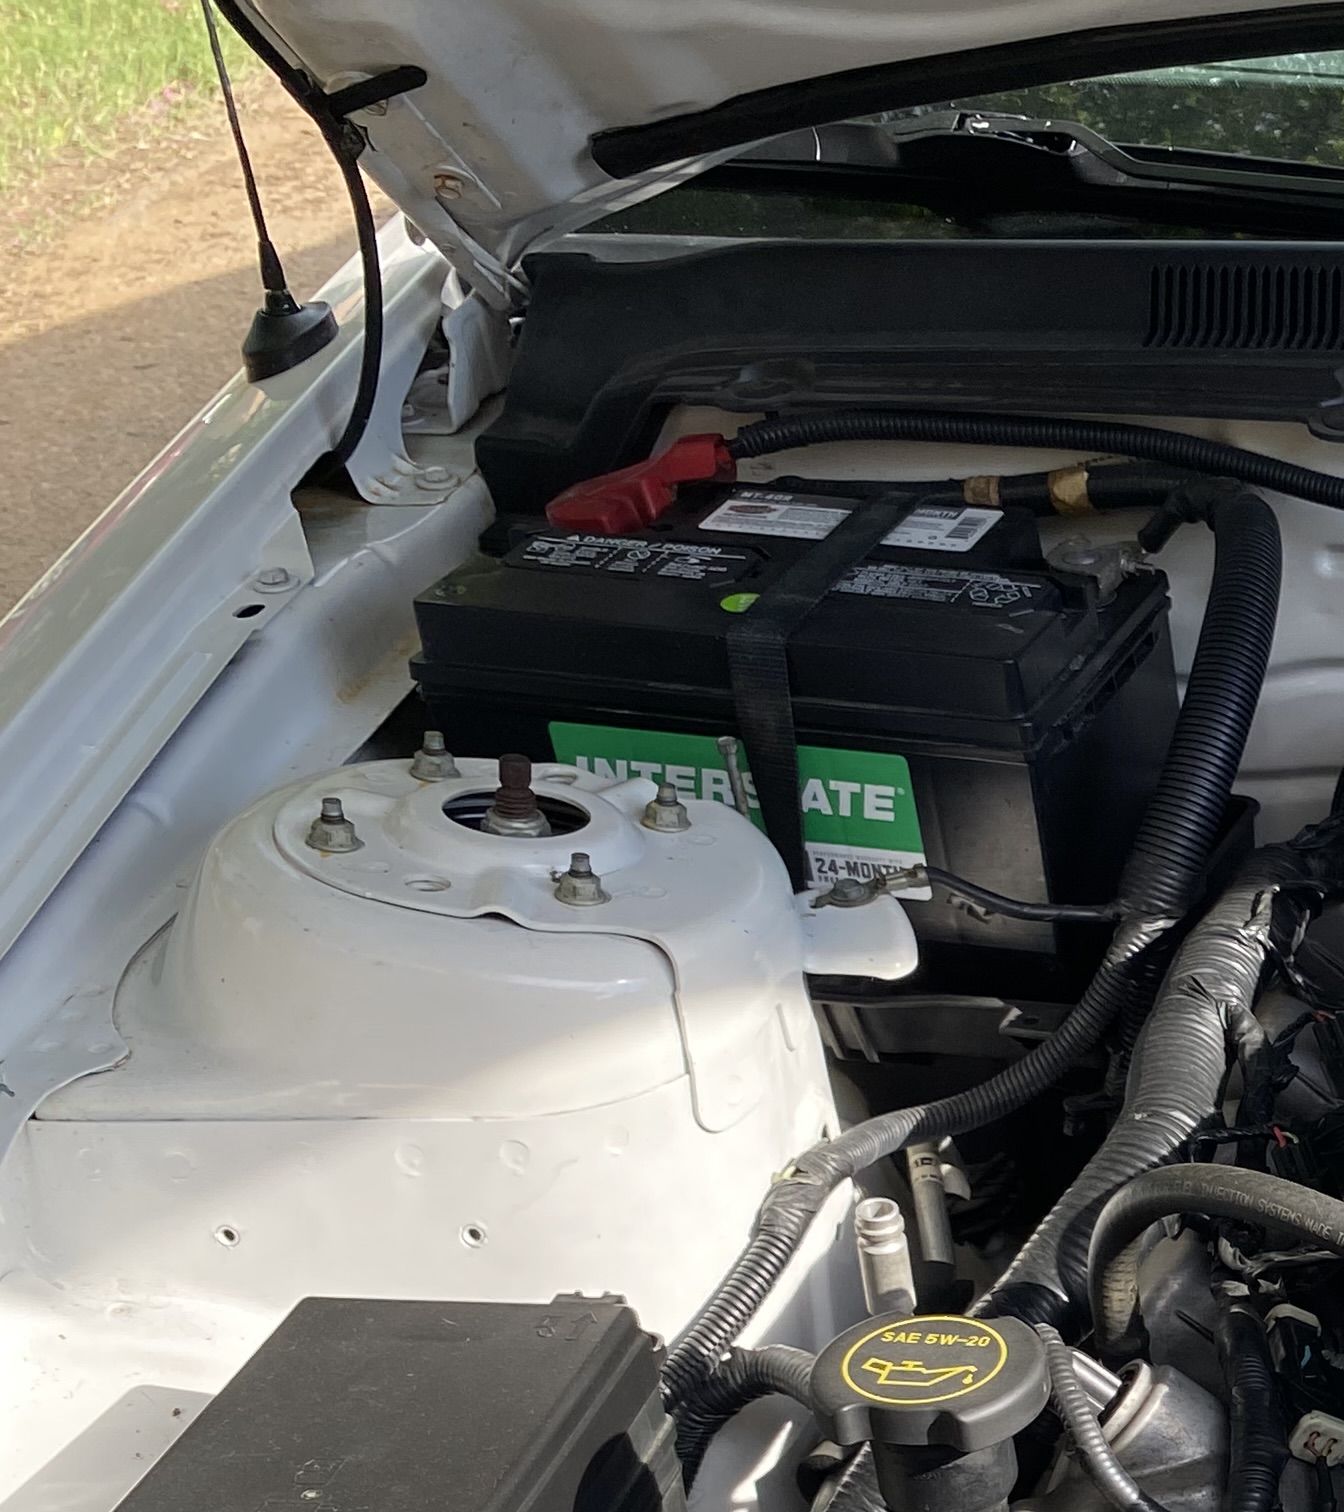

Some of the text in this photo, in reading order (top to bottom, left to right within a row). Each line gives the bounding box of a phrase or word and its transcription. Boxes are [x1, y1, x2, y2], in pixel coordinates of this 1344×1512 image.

[583, 536, 722, 555] DANGER POISON
[1258, 1198, 1302, 1224] SYSTEMS
[1305, 1217, 1333, 1240] MADE
[881, 1331, 991, 1348] SAE 5W-20
